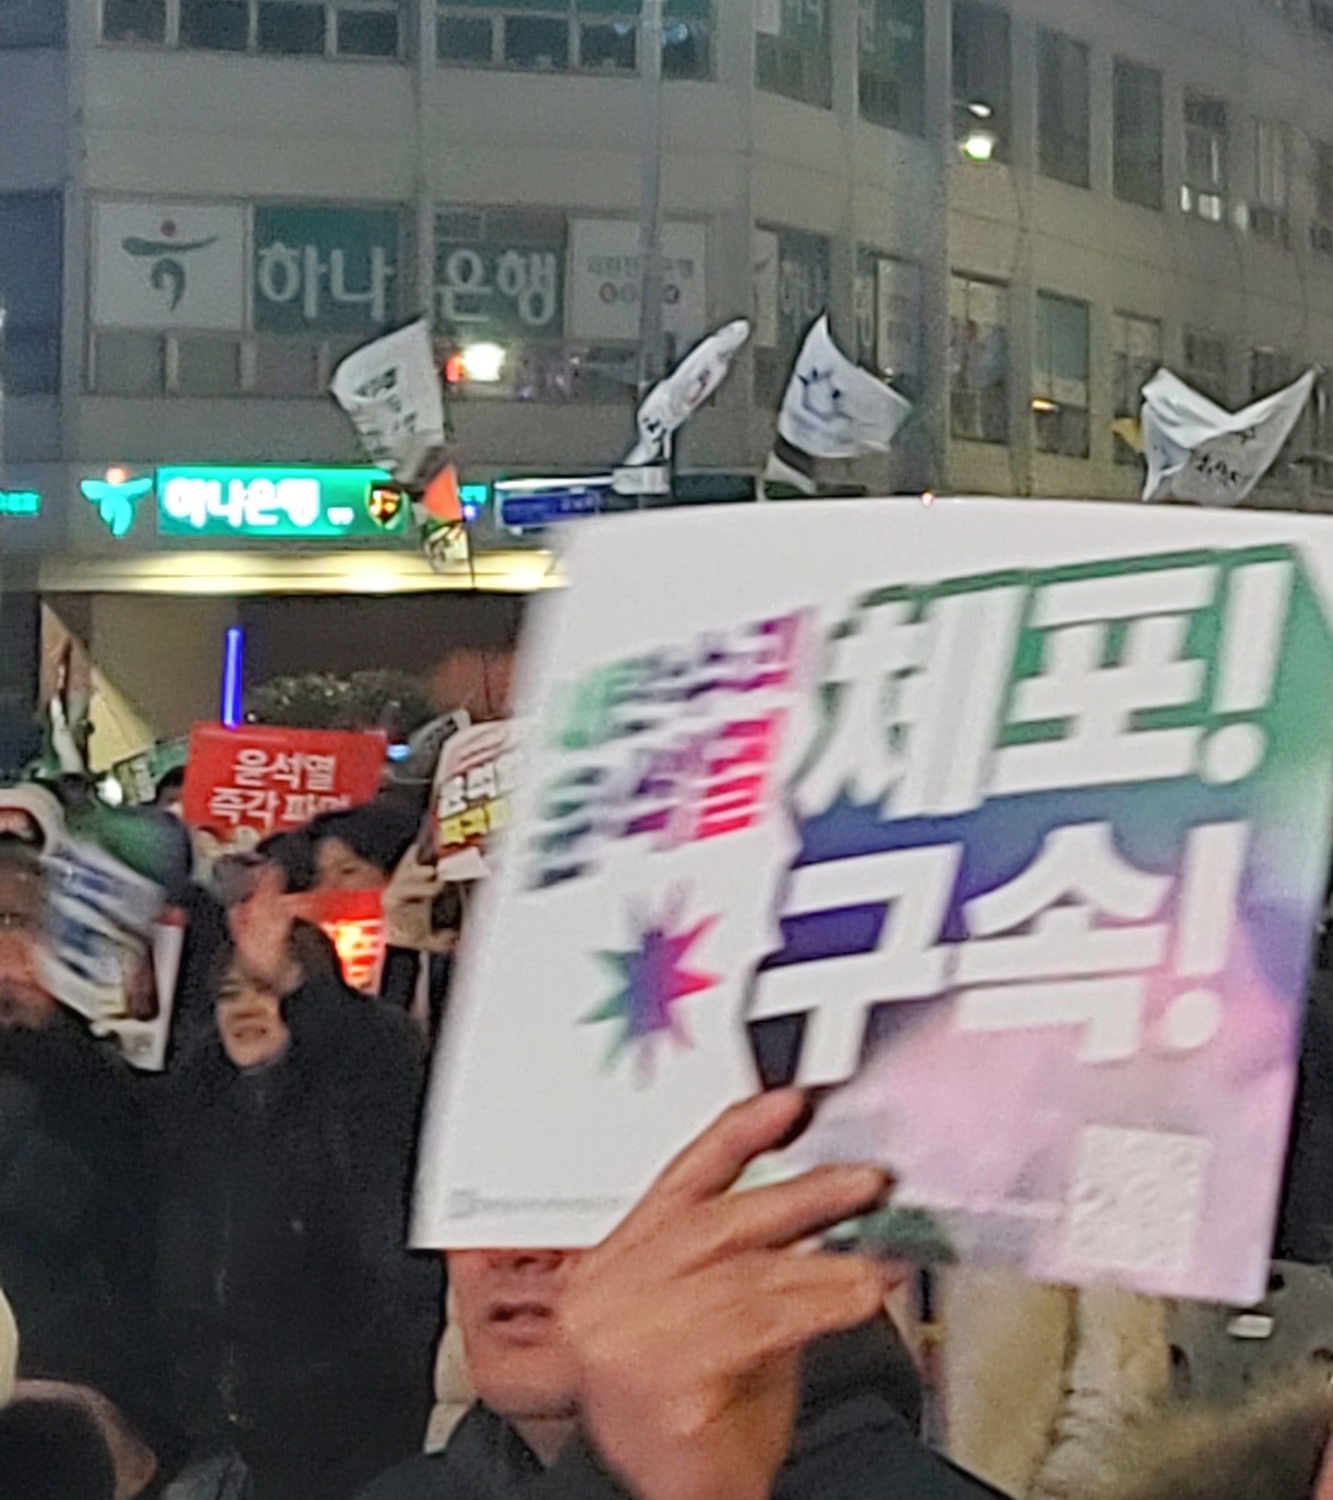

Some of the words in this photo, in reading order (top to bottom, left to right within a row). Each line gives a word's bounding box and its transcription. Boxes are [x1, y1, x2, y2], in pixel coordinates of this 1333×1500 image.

[257, 244, 396, 324] 하나
[440, 248, 557, 327] 은행
[163, 475, 324, 527] 하나은행
[802, 558, 1297, 818] 체포!
[232, 748, 337, 792] 윤석열
[208, 786, 280, 828] 즉각
[747, 821, 1250, 1088] 구속!
